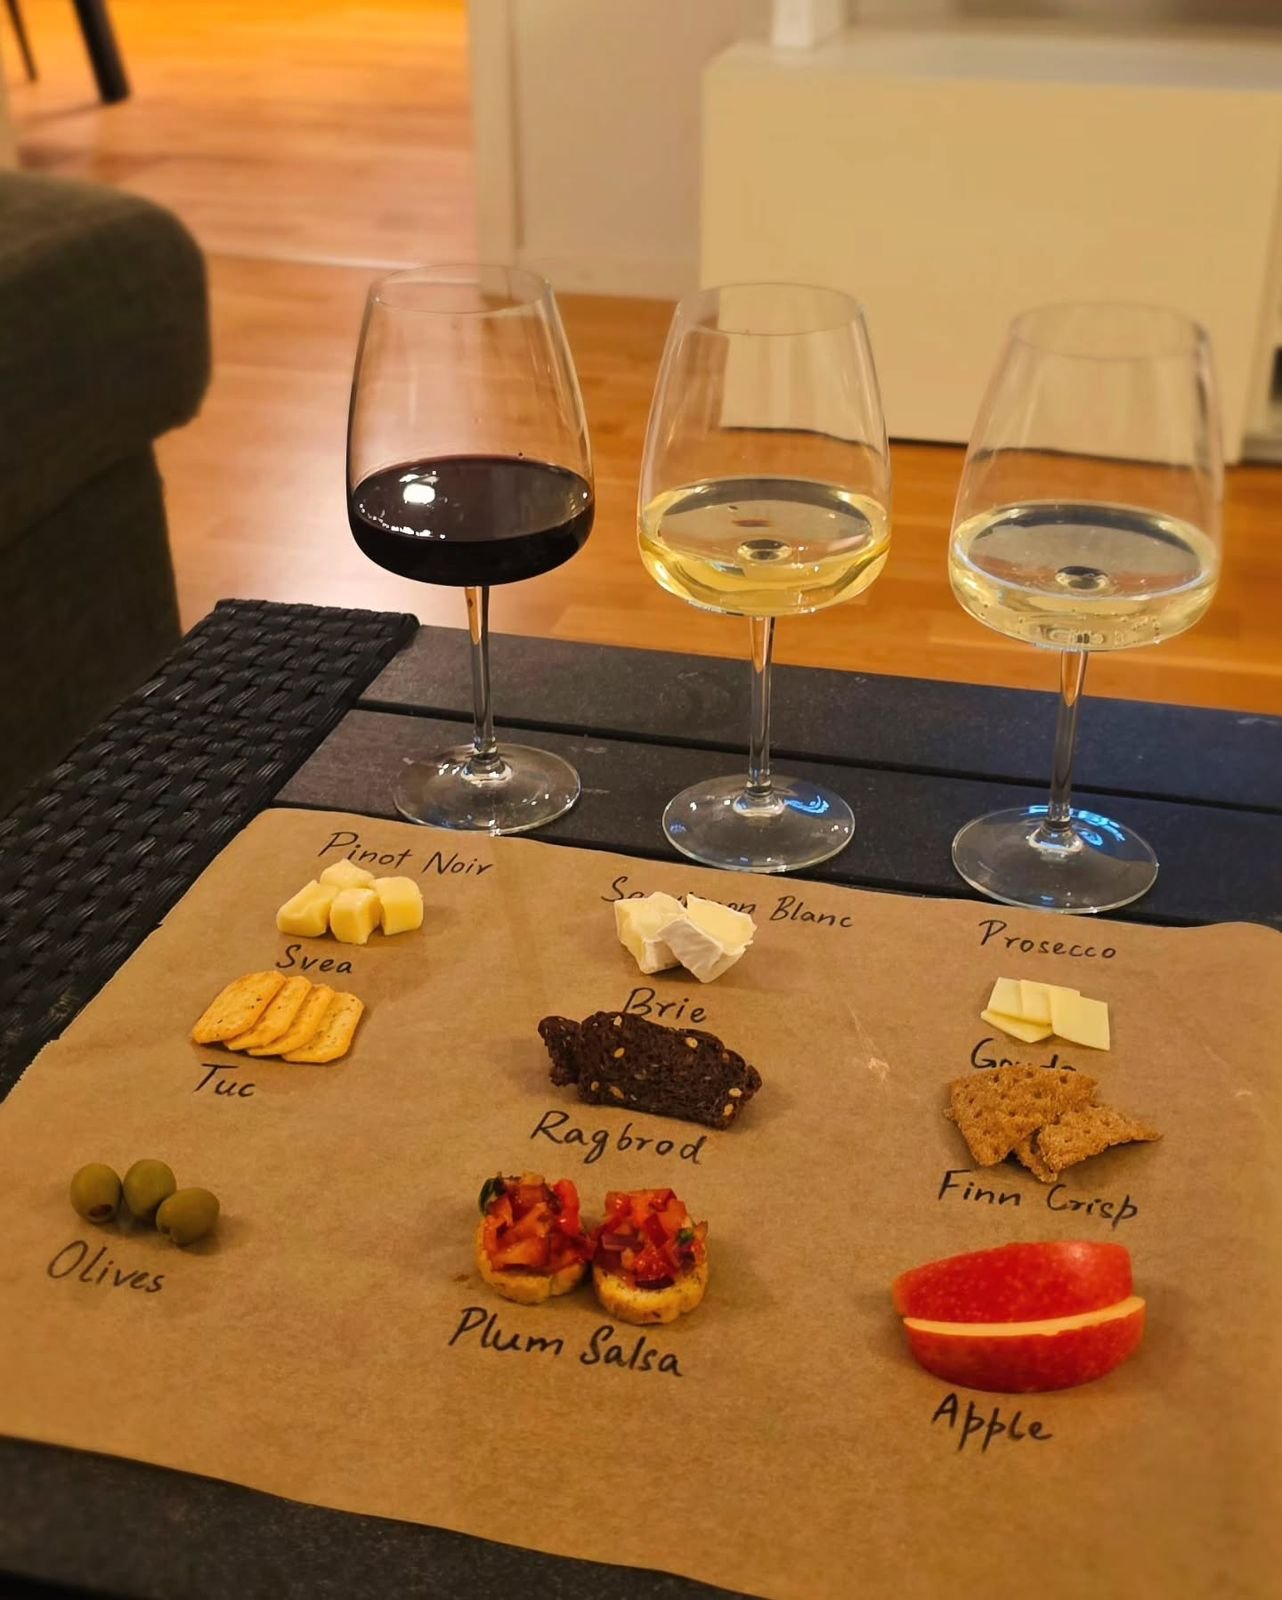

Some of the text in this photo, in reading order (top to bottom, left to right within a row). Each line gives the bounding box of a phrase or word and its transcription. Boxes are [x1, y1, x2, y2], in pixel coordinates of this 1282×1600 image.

[318, 831, 494, 876] Pinot Noir
[769, 895, 853, 928] Blanc
[275, 943, 353, 974] Svea
[978, 919, 1117, 960] Prosecco
[622, 987, 707, 1023] Brie
[192, 1063, 256, 1098] Tuc
[530, 1110, 707, 1165] Ragbrod
[938, 1169, 1139, 1231] Finn Crisp
[47, 1239, 165, 1293] Olives
[448, 1306, 684, 1377] Plum Salsa
[931, 1392, 1054, 1454] Apple
